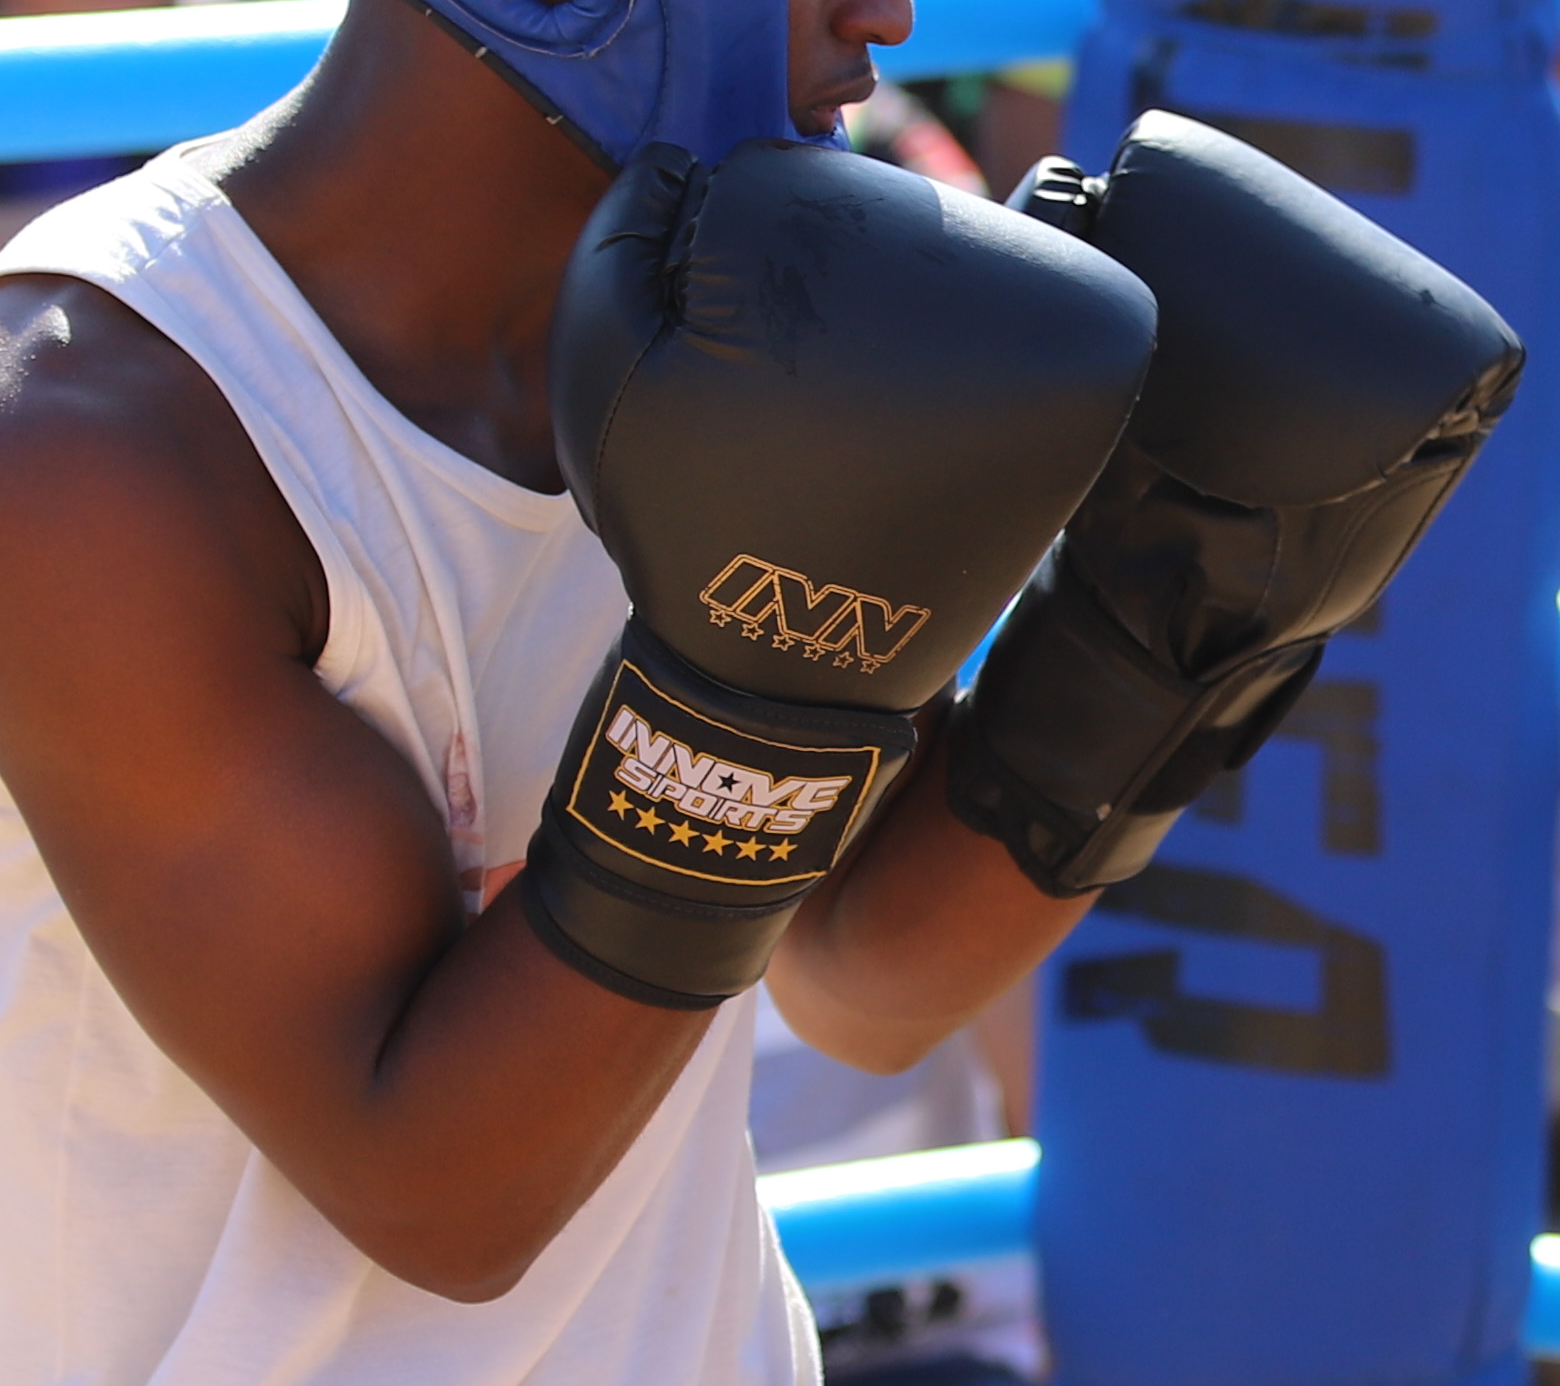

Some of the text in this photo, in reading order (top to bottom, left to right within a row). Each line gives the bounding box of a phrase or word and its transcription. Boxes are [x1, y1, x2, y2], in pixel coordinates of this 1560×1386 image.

[699, 553, 931, 664] INN
[605, 704, 852, 812] INNOVE
[614, 757, 818, 834] SPORTS
